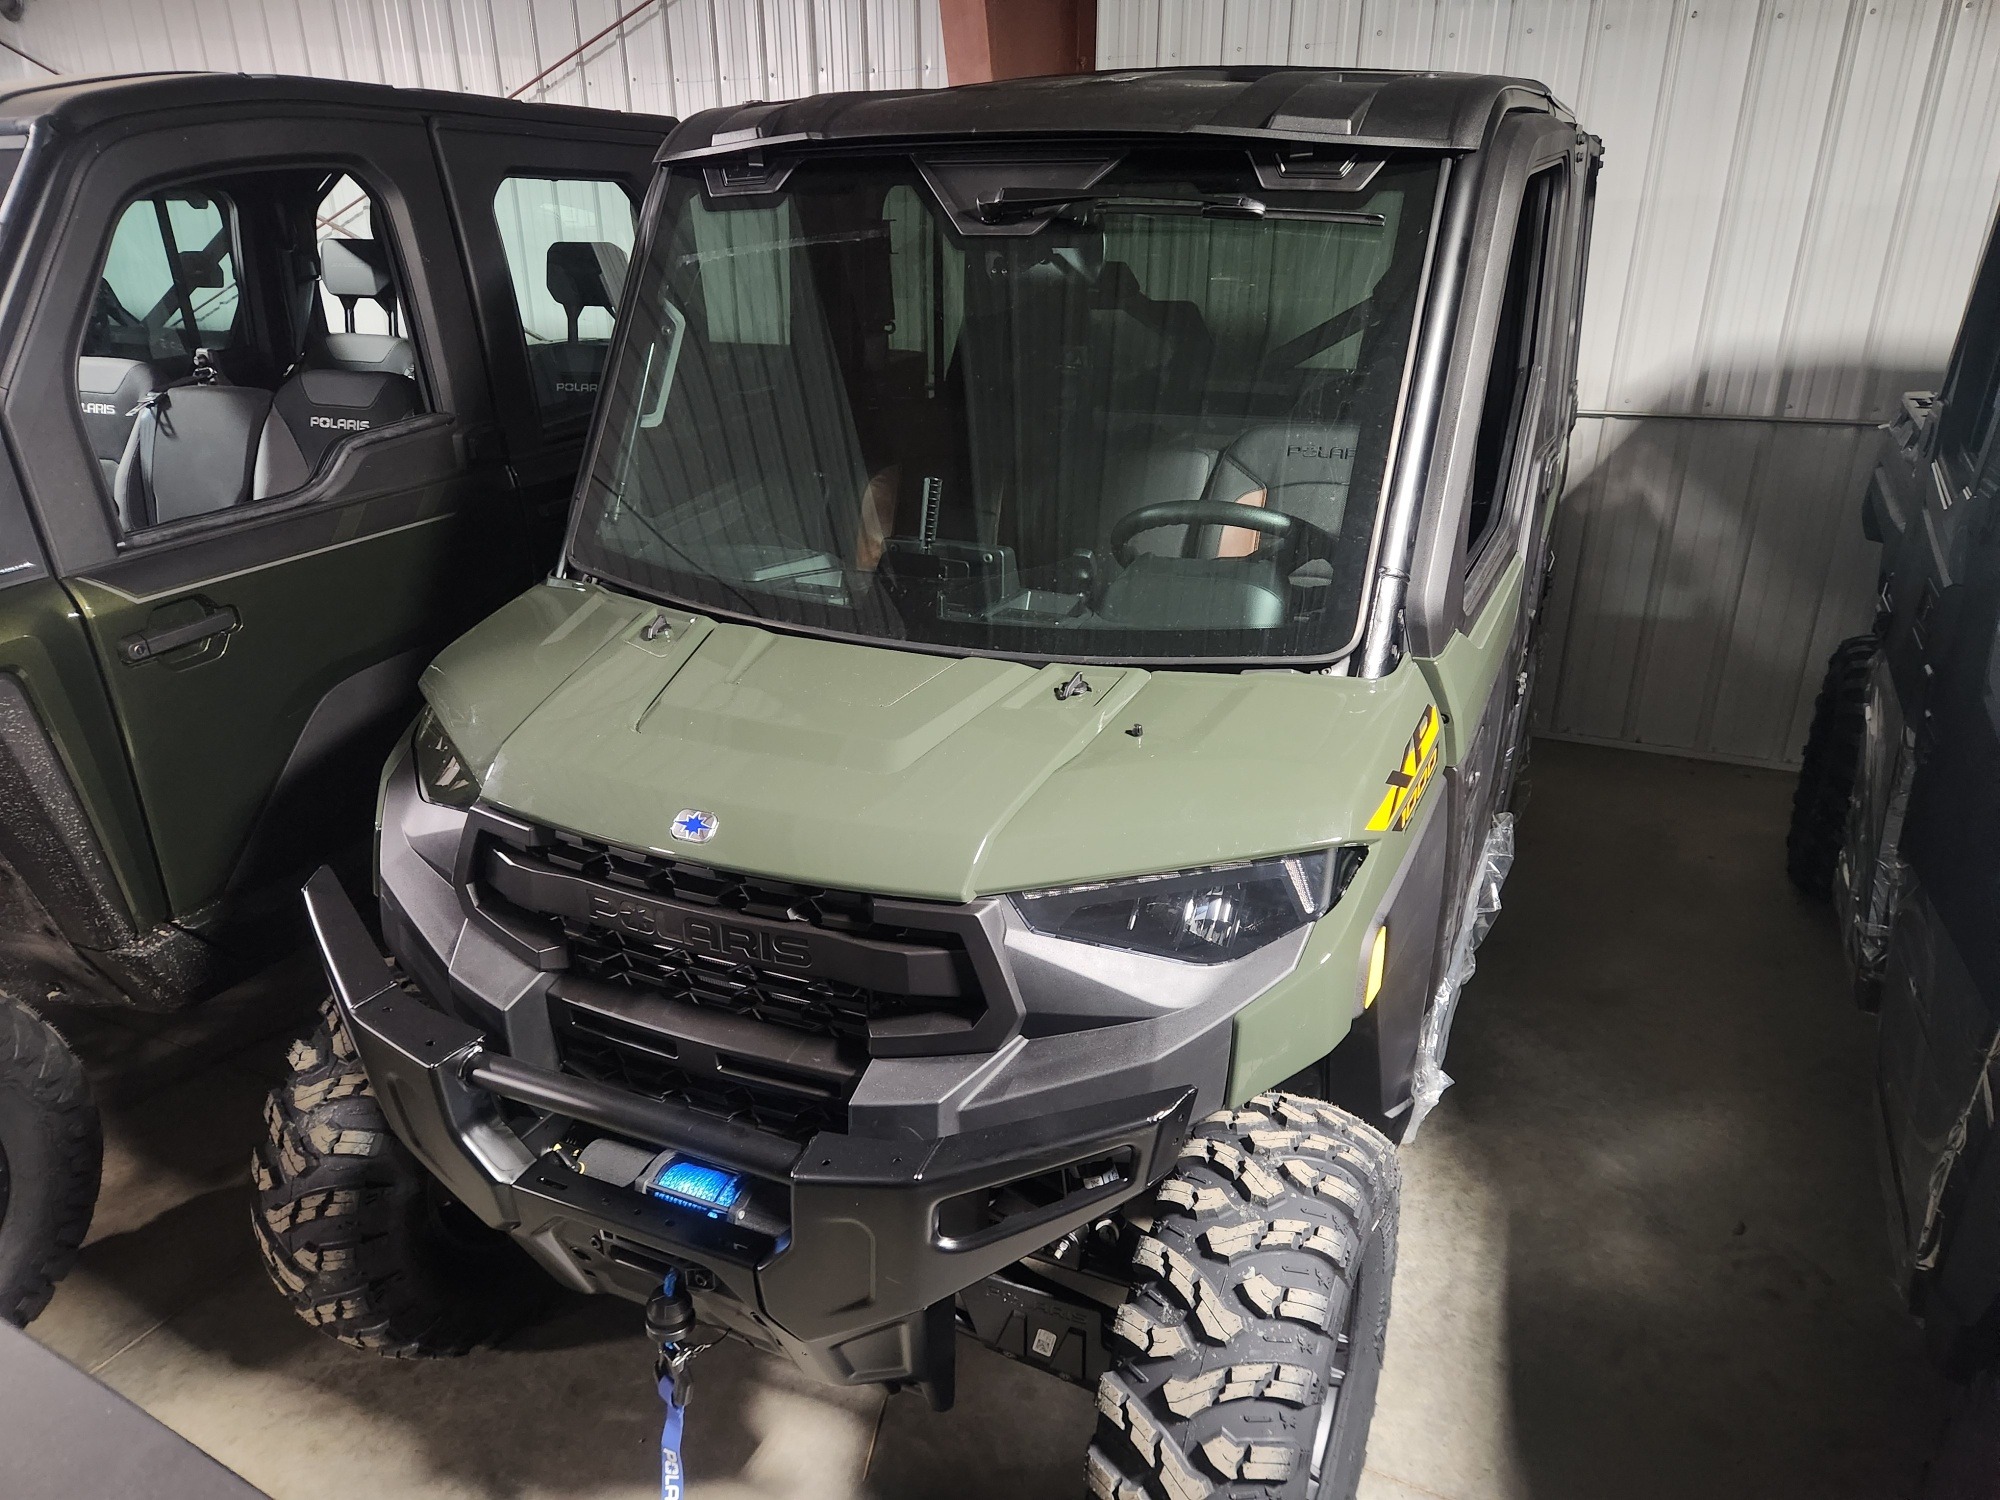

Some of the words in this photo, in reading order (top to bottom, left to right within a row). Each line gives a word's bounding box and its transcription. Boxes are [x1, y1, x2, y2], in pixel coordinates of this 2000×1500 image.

[310, 416, 370, 431] POLARIS
[1367, 704, 1439, 831] XP
[1396, 743, 1439, 831] 1000
[586, 889, 813, 969] POLARIS
